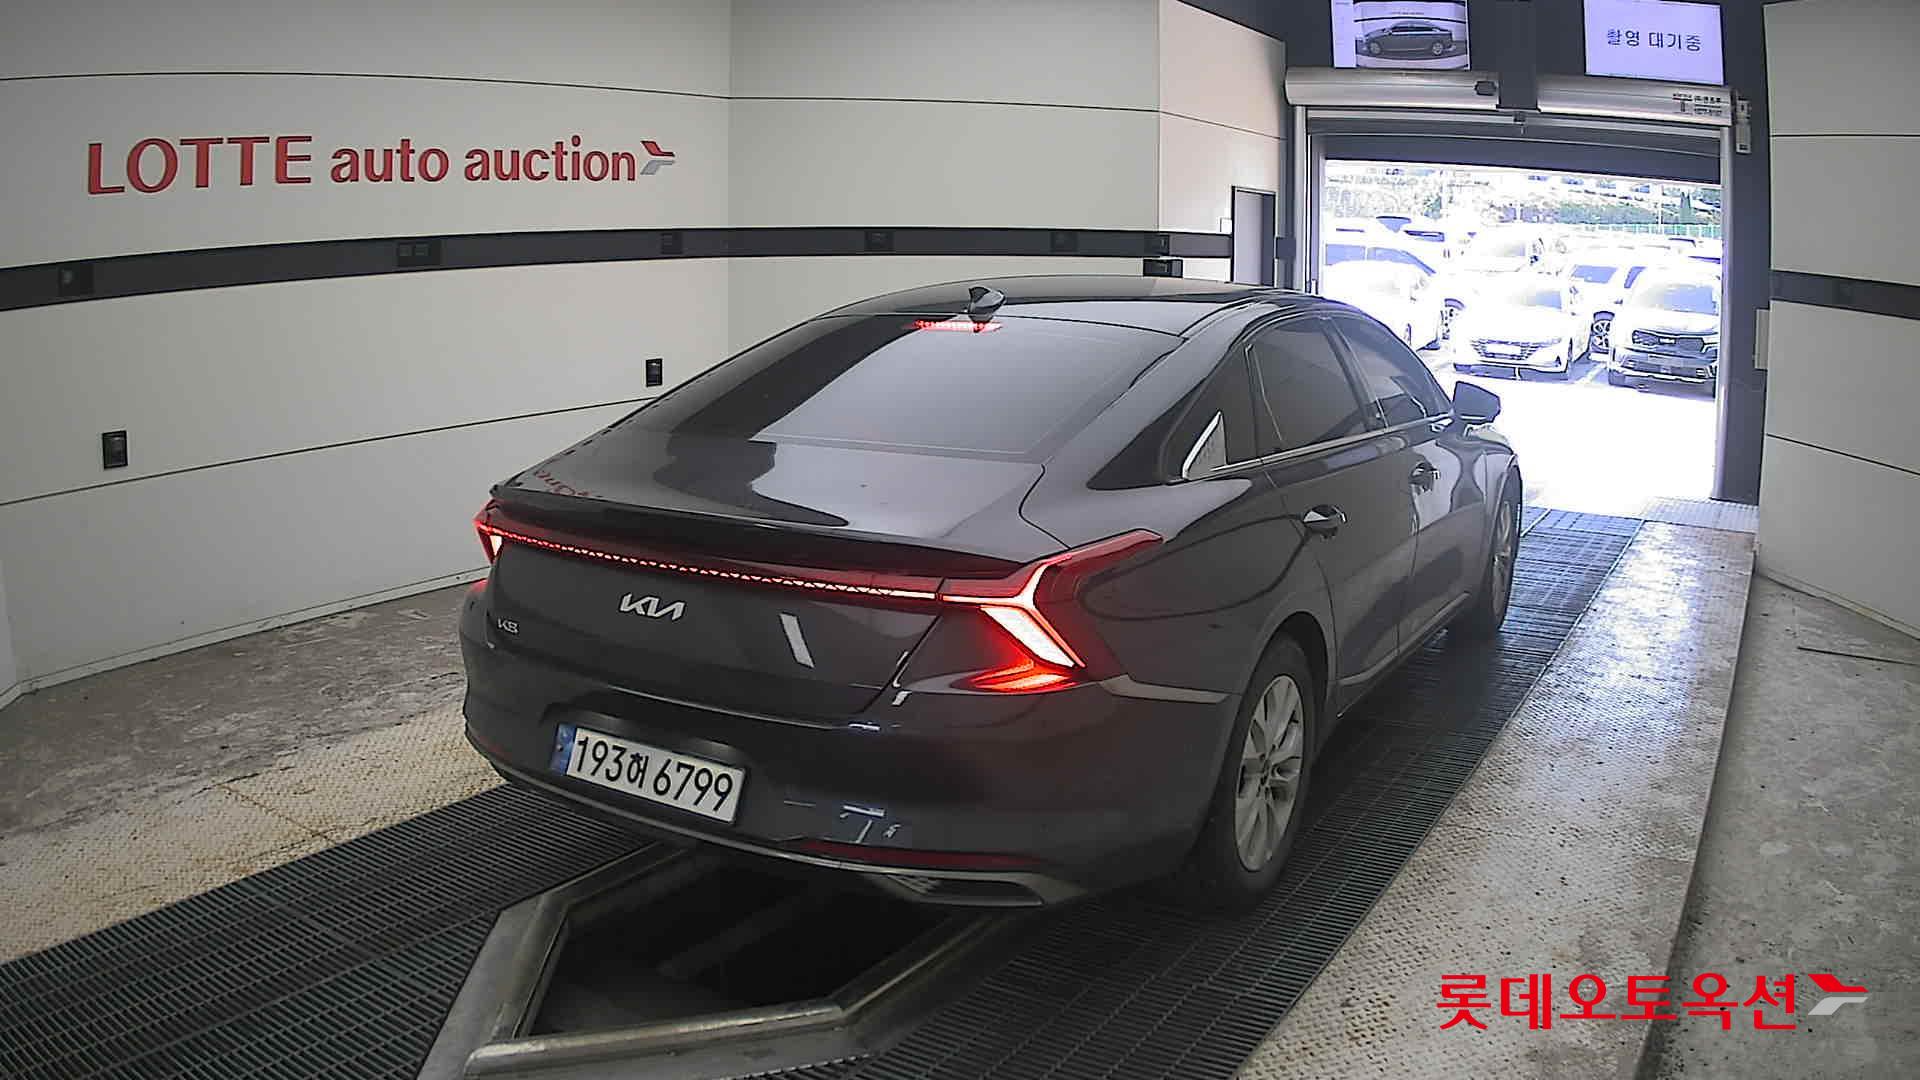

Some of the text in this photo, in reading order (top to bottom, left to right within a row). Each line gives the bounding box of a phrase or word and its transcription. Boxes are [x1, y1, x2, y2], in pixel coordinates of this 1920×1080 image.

[1648, 31, 1702, 53] 대기중
[87, 134, 637, 195] LOTTE auto auction
[619, 592, 686, 622] KIA
[497, 617, 520, 634] K8
[576, 735, 734, 812] 193허 6799
